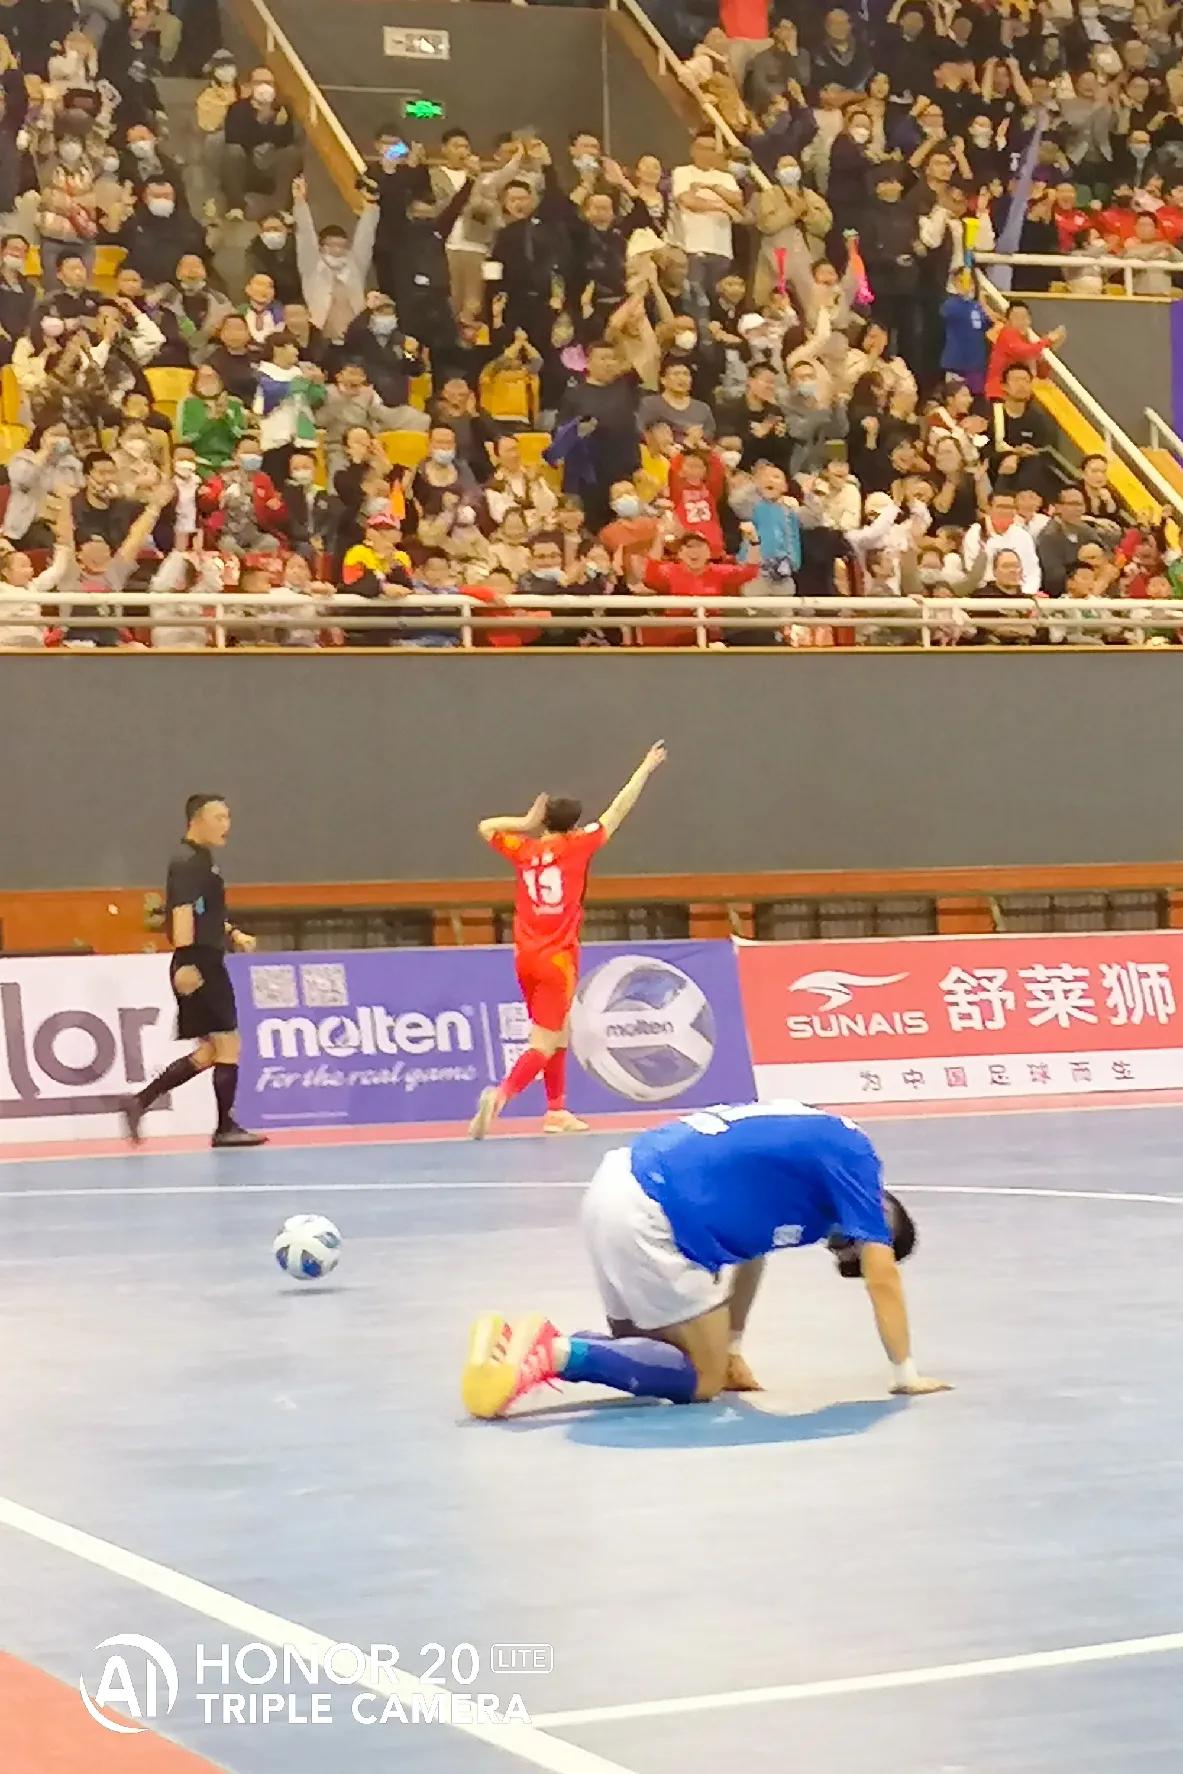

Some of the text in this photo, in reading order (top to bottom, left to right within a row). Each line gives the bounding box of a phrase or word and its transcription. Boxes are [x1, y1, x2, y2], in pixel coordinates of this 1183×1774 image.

[938, 960, 1177, 1032] 舒莱狮
[256, 1005, 473, 1059] molten
[786, 1009, 929, 1040] SUNAIS
[256, 1065, 301, 1092] For
[302, 1063, 345, 1088] the
[348, 1060, 405, 1086] real
